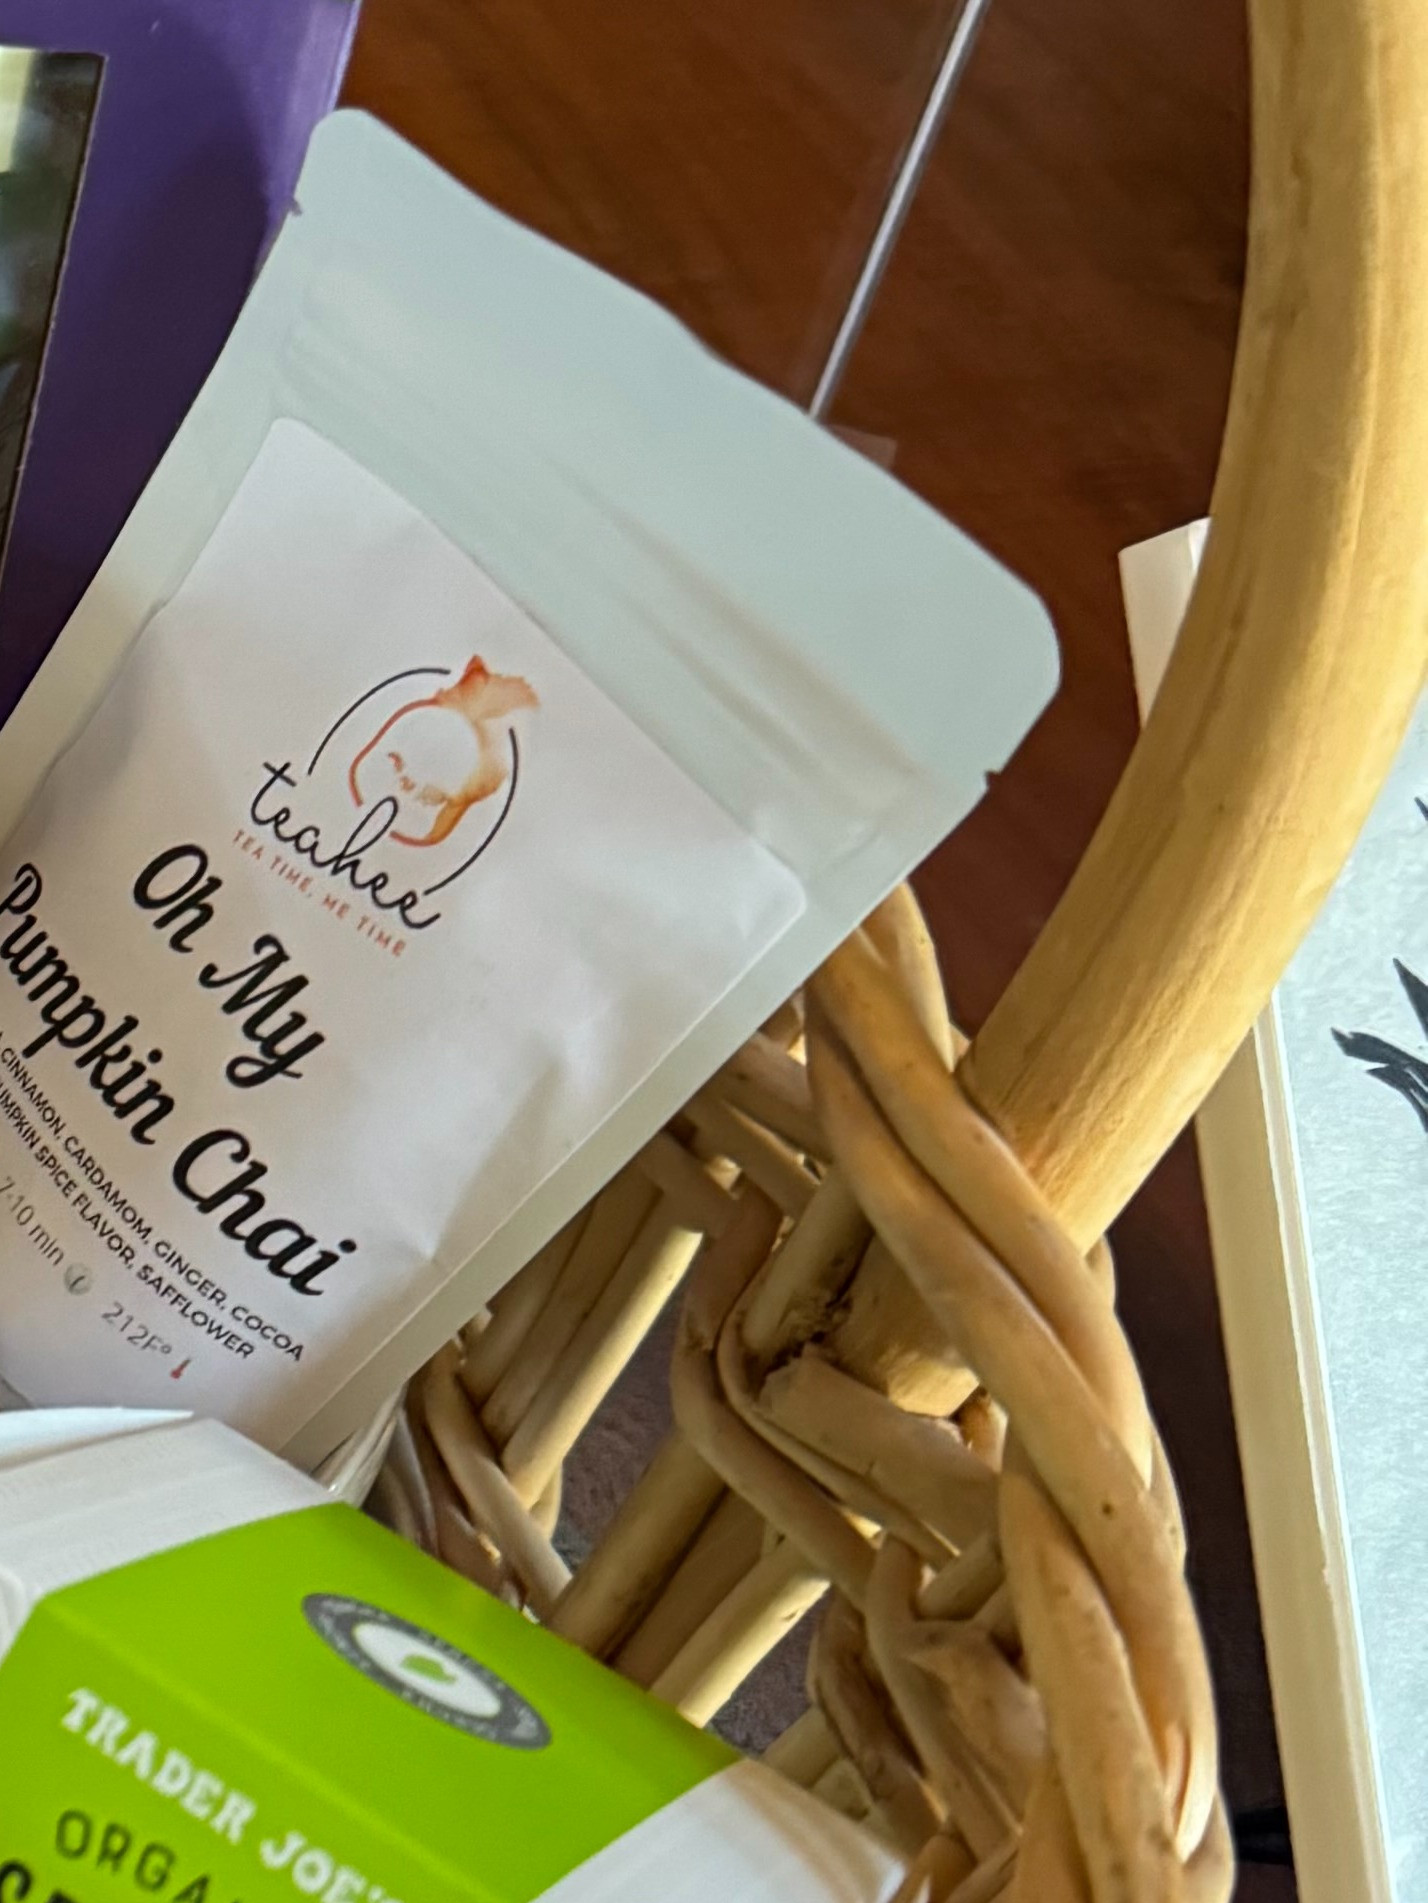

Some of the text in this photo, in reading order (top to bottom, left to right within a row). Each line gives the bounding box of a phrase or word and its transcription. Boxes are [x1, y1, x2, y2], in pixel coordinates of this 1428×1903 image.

[232, 829, 263, 862] TEA
[323, 894, 349, 920] ME
[357, 916, 406, 958] TIME
[251, 761, 442, 929] teahee
[133, 843, 326, 1088] Oh My
[29, 1222, 66, 1267] min
[35, 1146, 78, 1197] SPICE
[73, 1193, 134, 1269] FLAVOR,
[137, 1264, 255, 1359] SAFFLOWER
[64, 1136, 153, 1245] CARDAMOM,
[154, 1240, 227, 1310] GINGER,
[231, 1305, 305, 1361] COCOA
[172, 1129, 357, 1296] Chai
[61, 1686, 259, 1845] TRADER
